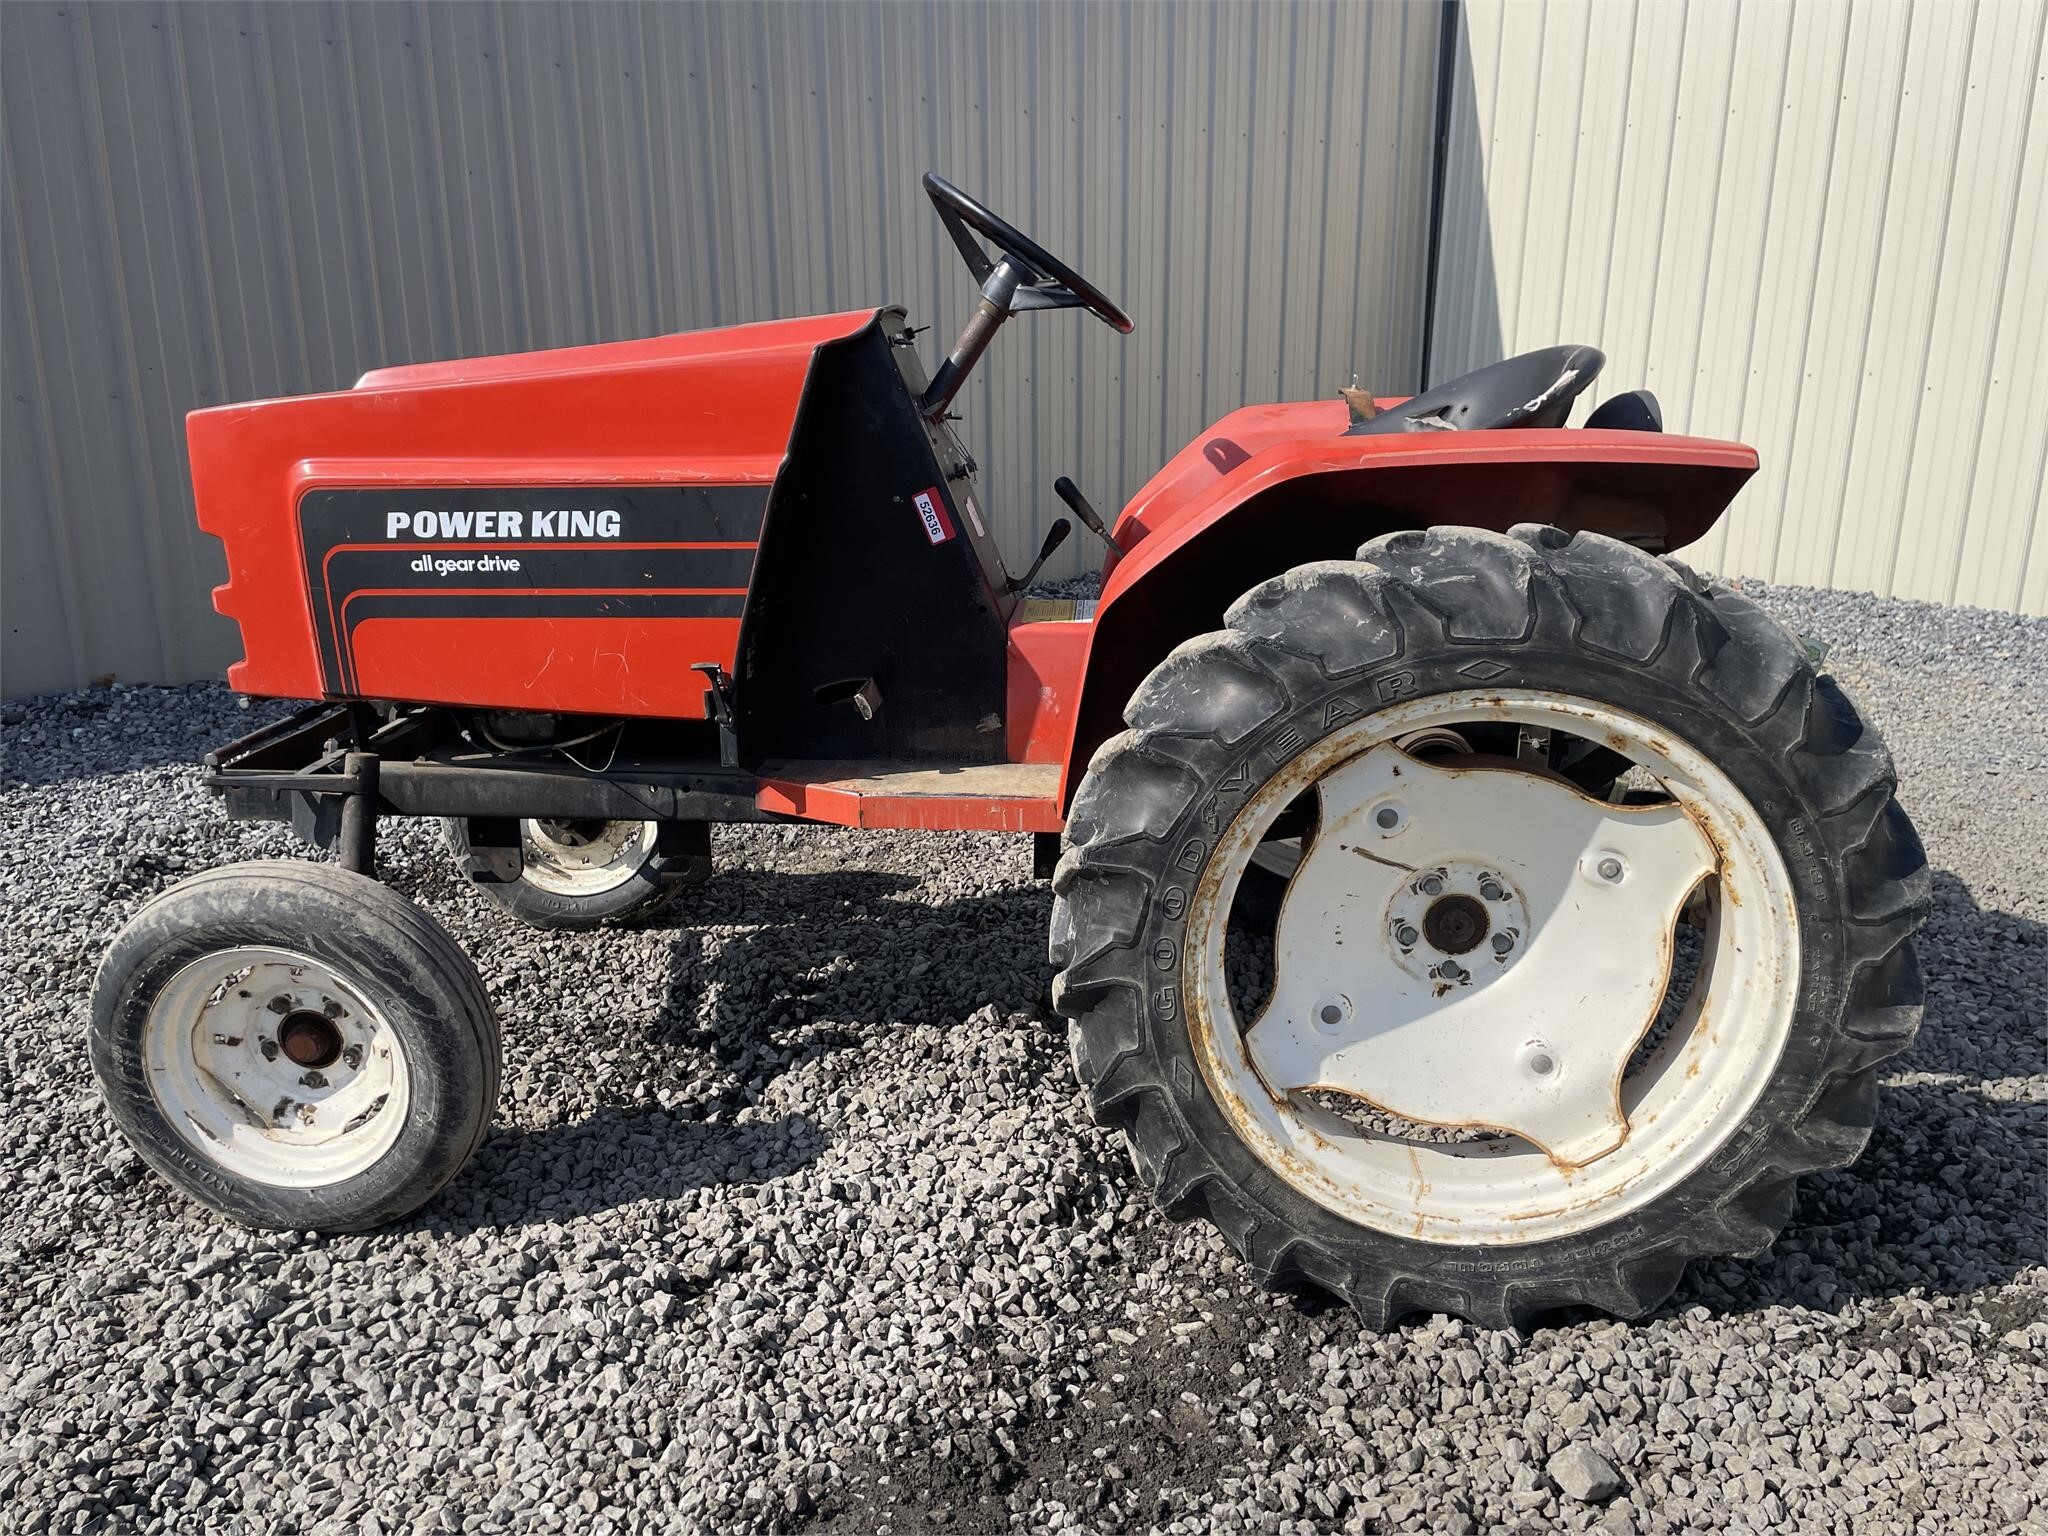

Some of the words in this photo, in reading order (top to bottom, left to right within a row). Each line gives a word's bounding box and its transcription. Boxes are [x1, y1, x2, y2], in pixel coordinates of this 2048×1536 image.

[386, 510, 524, 539] POWER
[531, 510, 621, 538] KING
[919, 501, 941, 536] 52636
[410, 554, 433, 572] all
[434, 557, 476, 576] gear
[477, 554, 521, 572] drive
[1153, 670, 1419, 1022] GOODYEAR
[168, 1147, 235, 1196] NYLON
